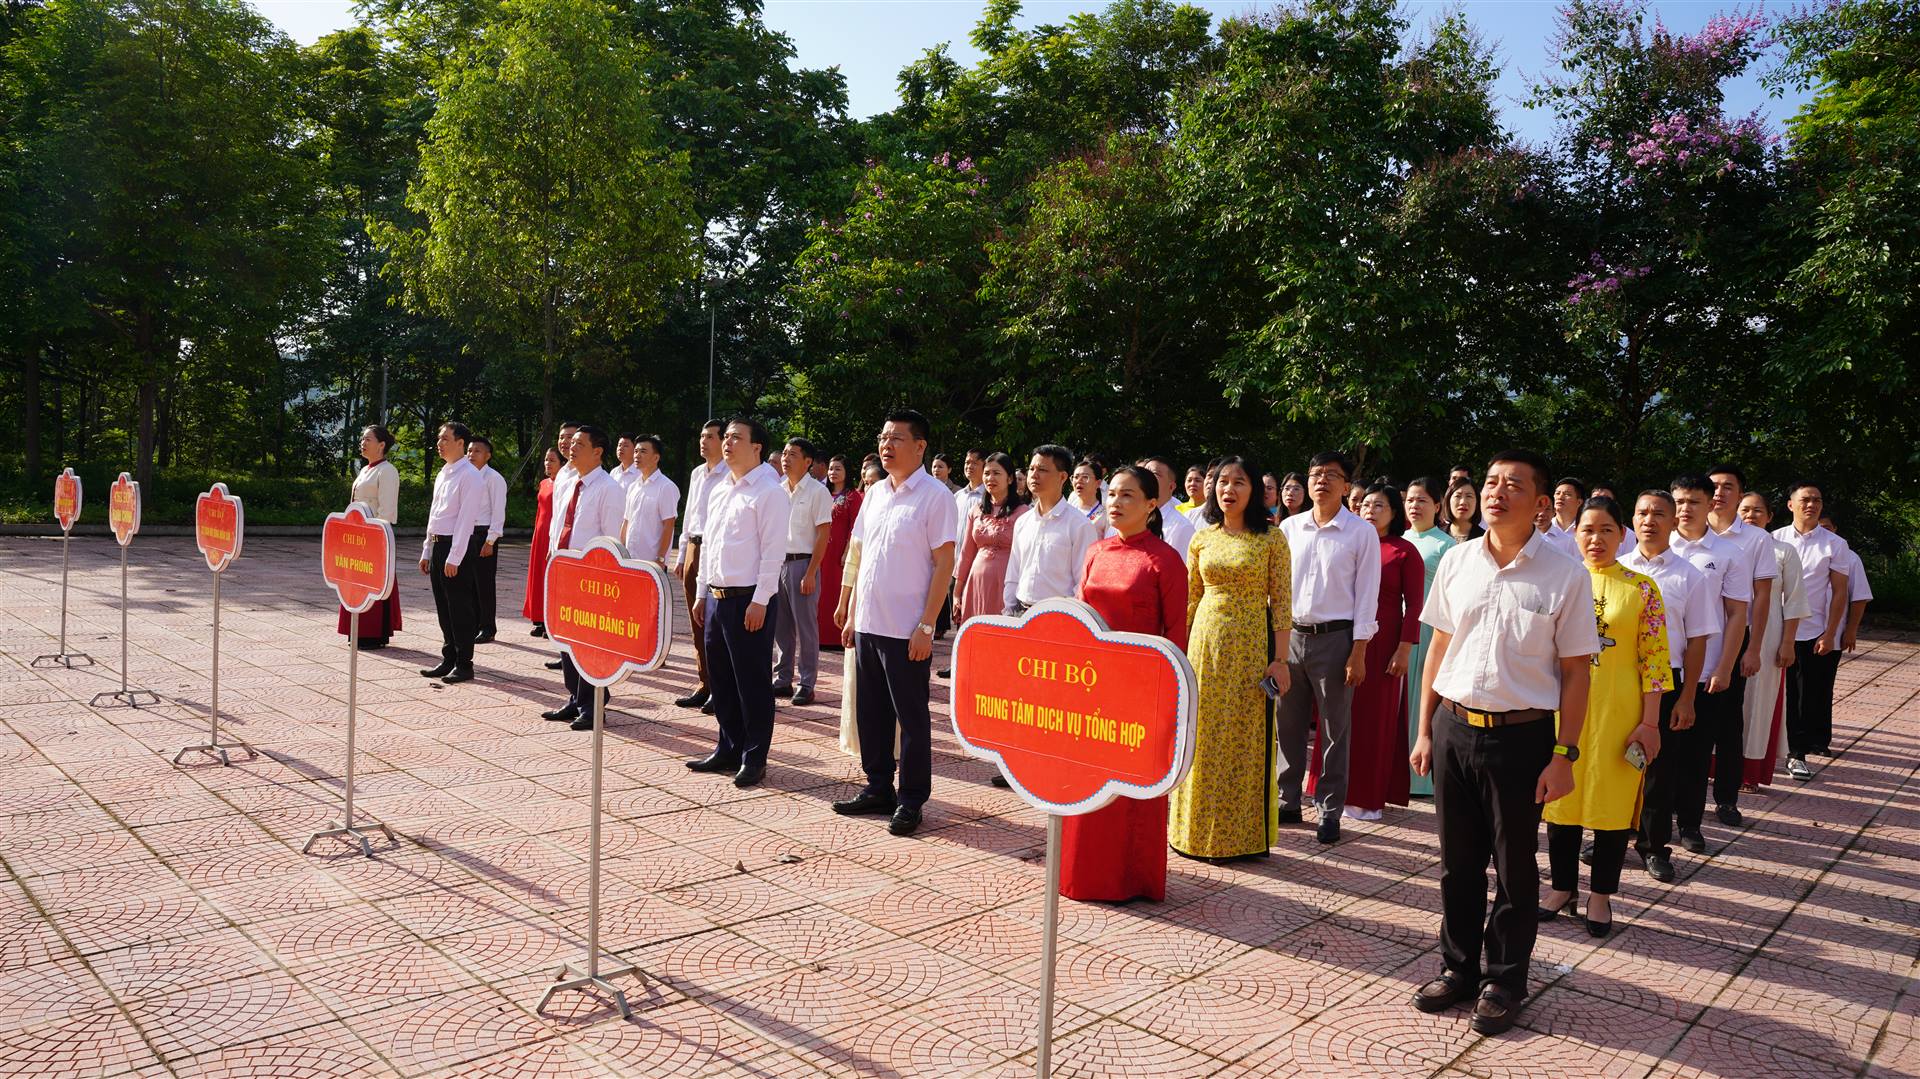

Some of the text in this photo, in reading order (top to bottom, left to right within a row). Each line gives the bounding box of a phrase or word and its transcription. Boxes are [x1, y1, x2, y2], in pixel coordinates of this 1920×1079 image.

[580, 578, 620, 603] CHI BỘ
[560, 605, 641, 640] CƠ QUAN ĐẢNG ỦY
[1017, 656, 1097, 692] CHI BỘ
[975, 694, 1146, 752] TRUNG TÂM DỊCH VỤ TỔNG HỢP
